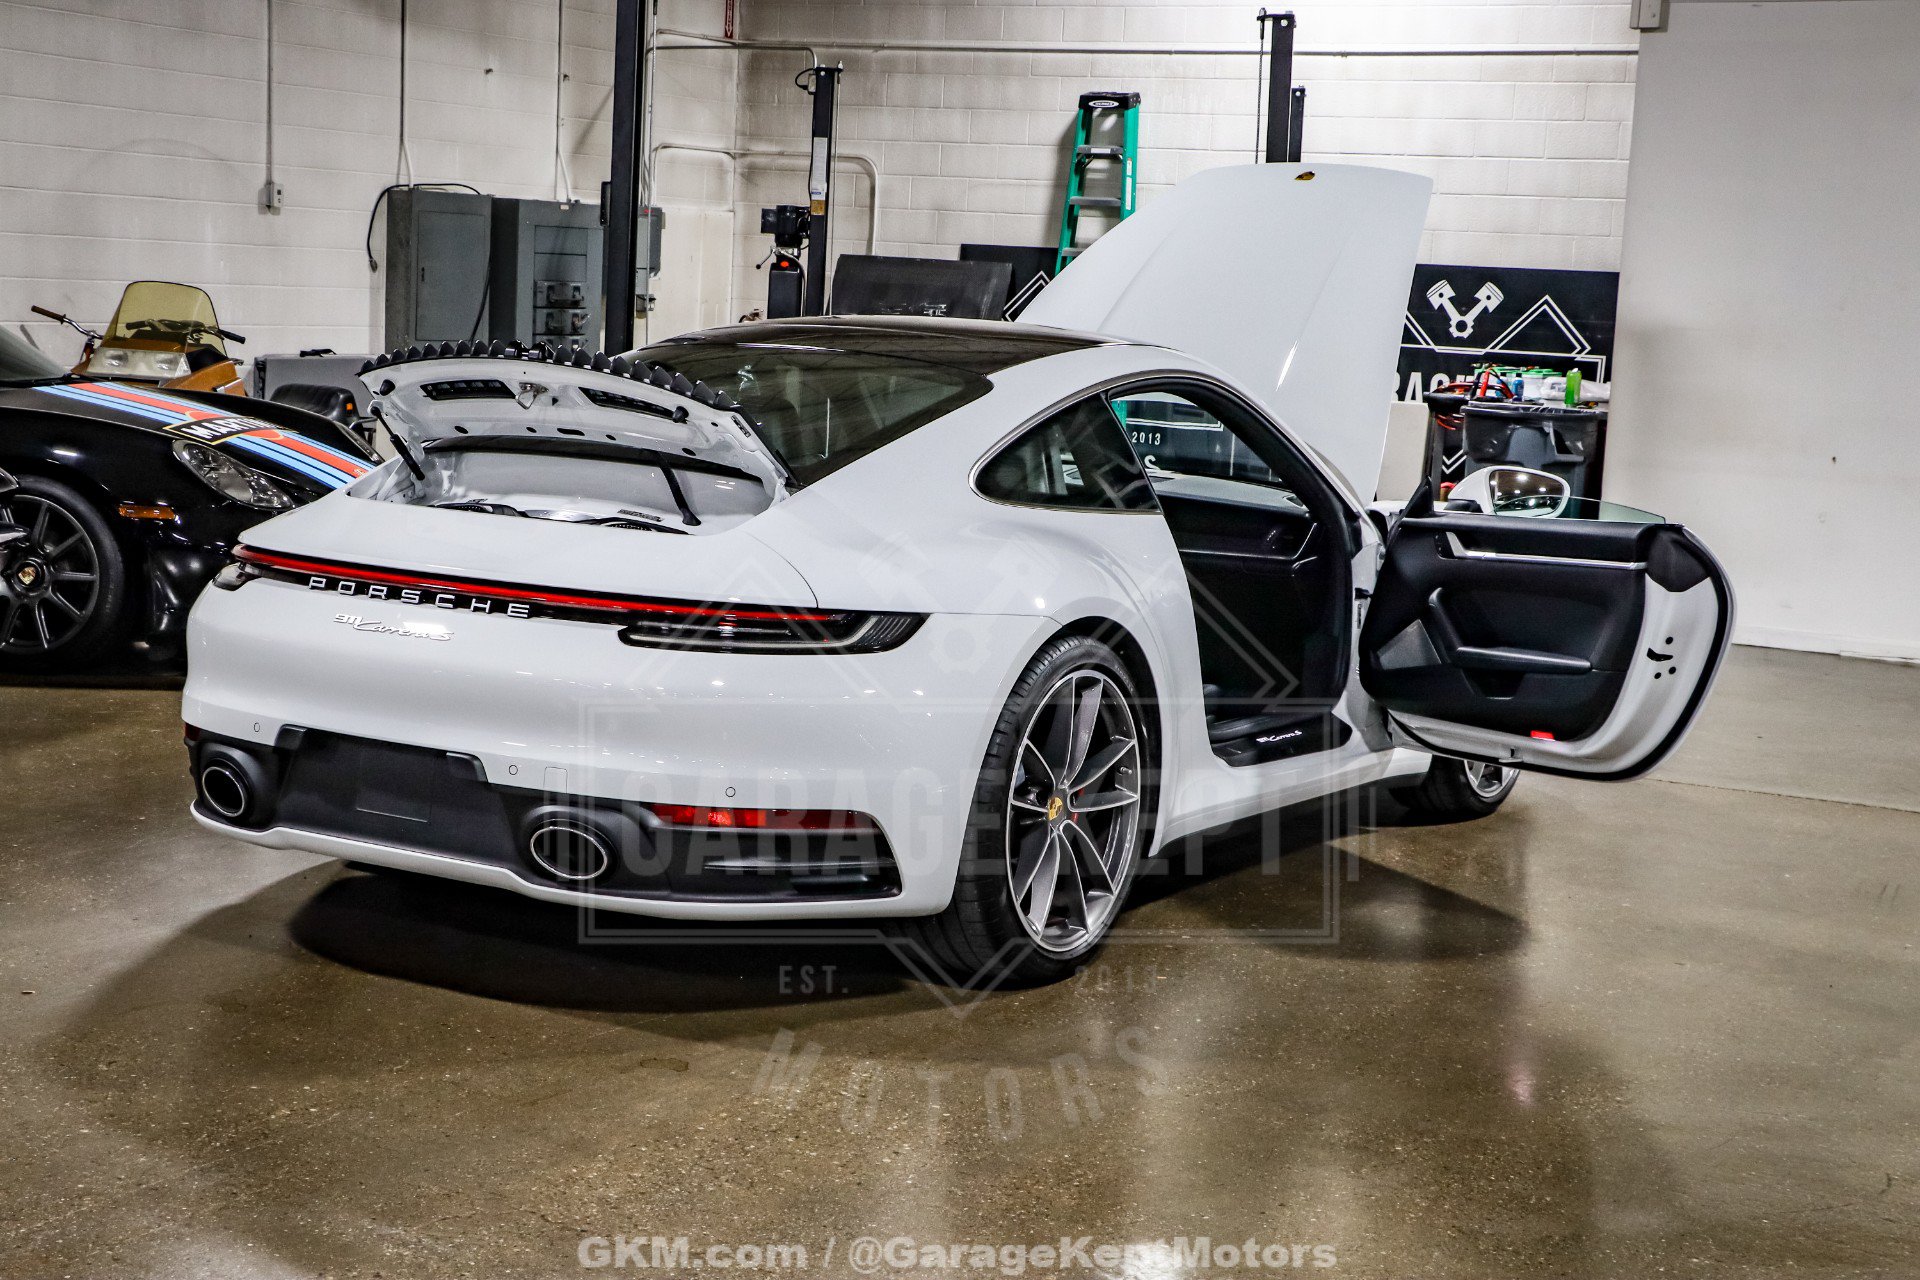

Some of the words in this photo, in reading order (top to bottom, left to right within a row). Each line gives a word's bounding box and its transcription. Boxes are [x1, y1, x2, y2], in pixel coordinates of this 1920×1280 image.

[180, 417, 276, 440] MART
[1131, 431, 1161, 446] 2013
[308, 576, 531, 619] PORSCHE
[333, 612, 363, 625] 911
[352, 620, 430, 639] Carrera
